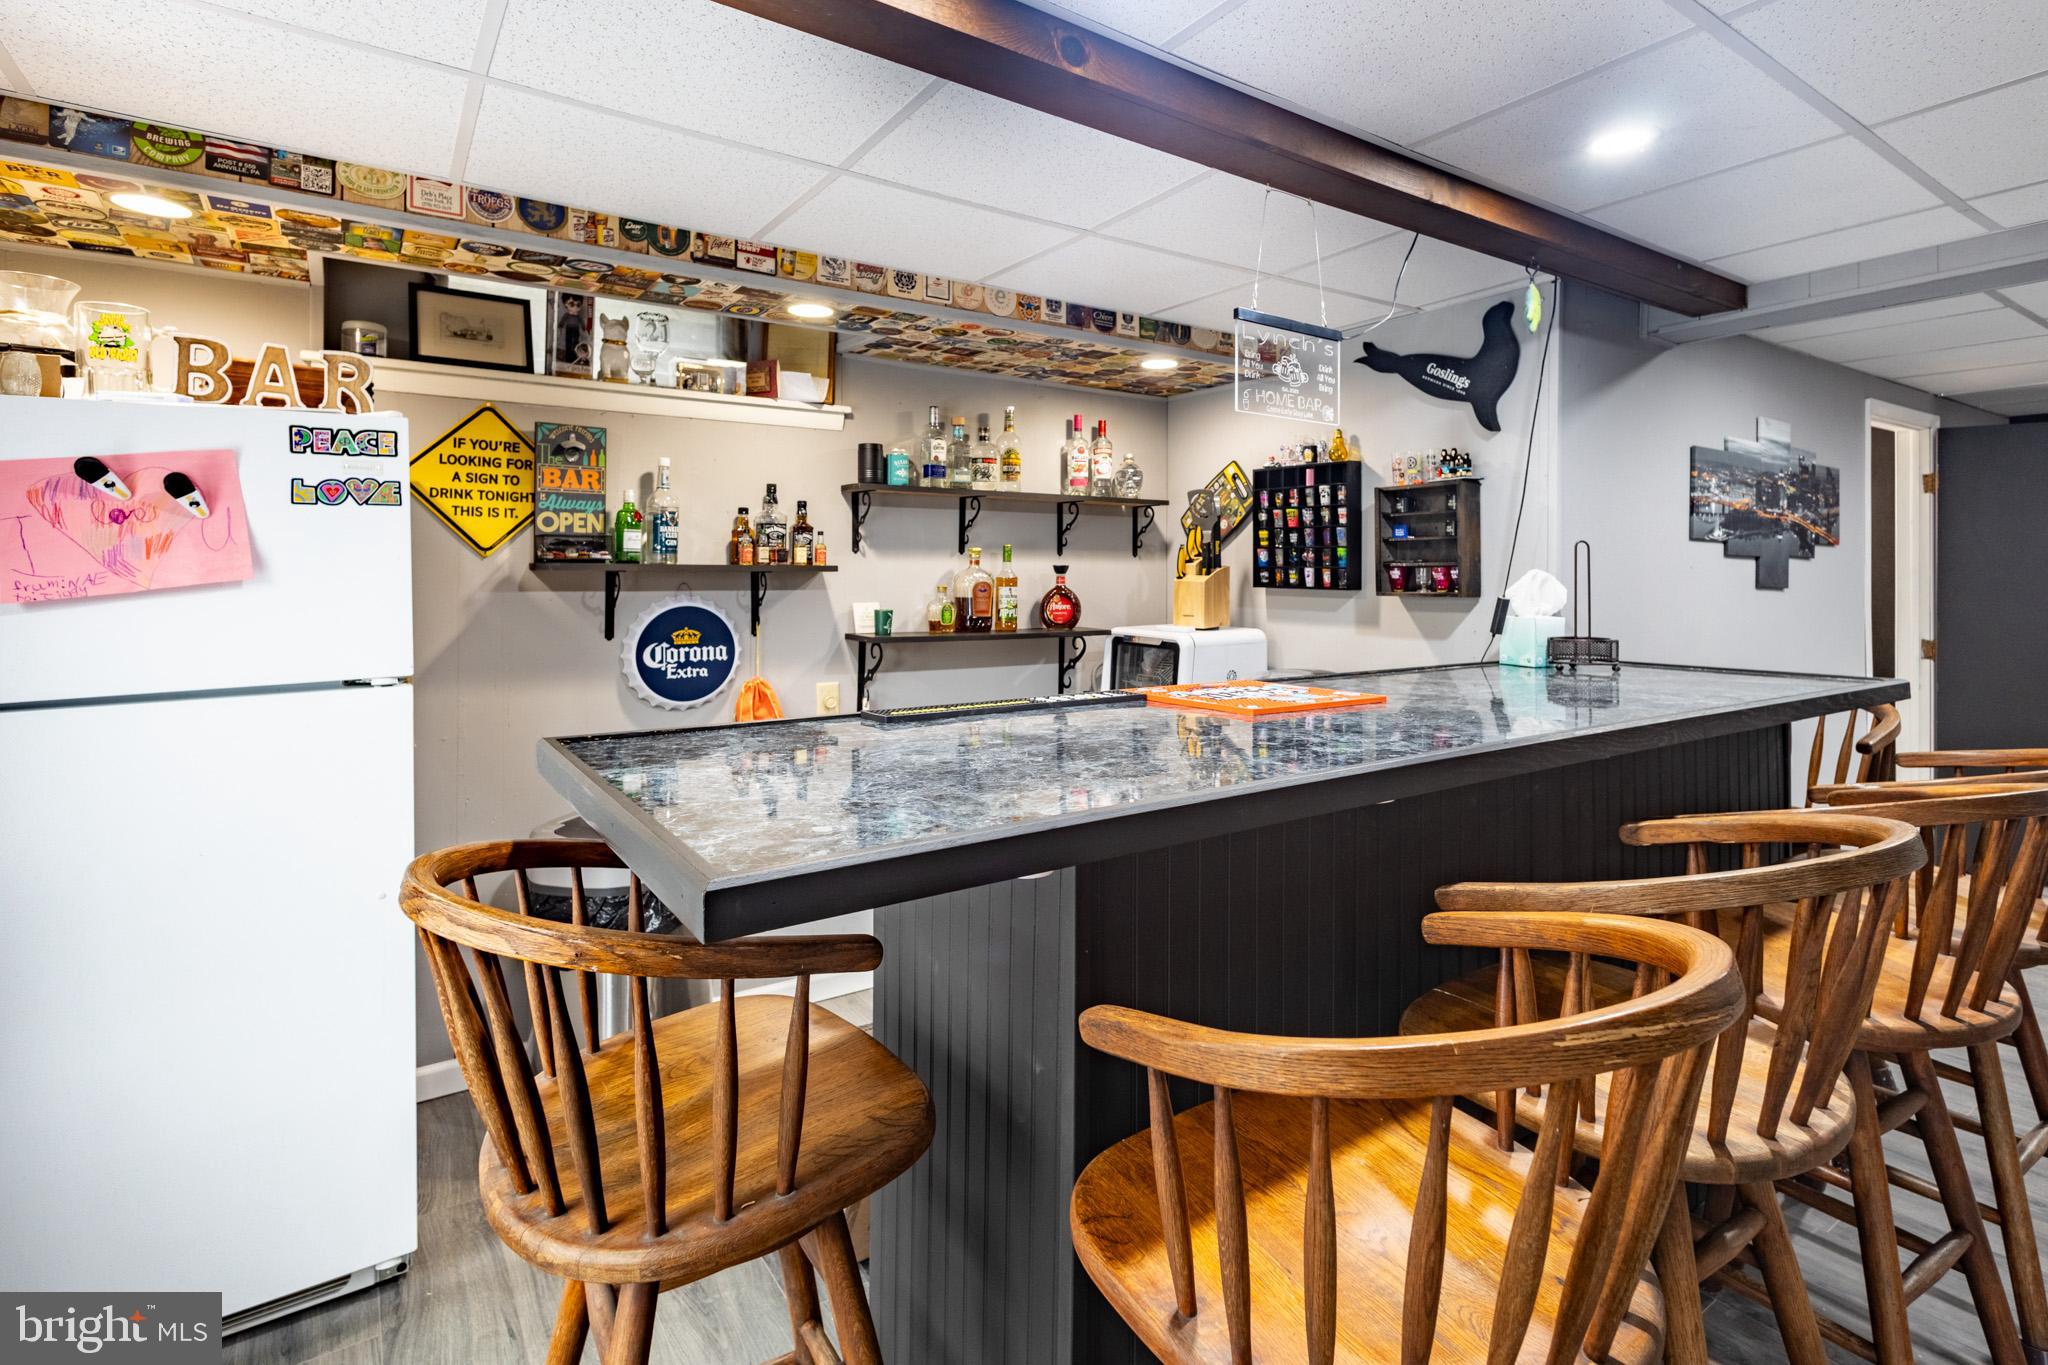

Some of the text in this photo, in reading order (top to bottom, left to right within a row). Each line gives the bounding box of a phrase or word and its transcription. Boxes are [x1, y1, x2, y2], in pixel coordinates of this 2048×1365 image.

[146, 132, 191, 147] BREWING
[143, 146, 191, 165] COMPANY
[217, 157, 238, 167] POST
[1242, 323, 1334, 357] Lynch's
[174, 334, 375, 415] BAR
[1426, 362, 1471, 389] Goslings
[1255, 388, 1296, 408] HOME
[1297, 395, 1323, 413] BAR
[289, 425, 398, 457] PEACE
[453, 438, 520, 453] IF YOU'RE
[439, 454, 533, 470] LOOKING FOR
[452, 473, 520, 485] A SIGN TO
[543, 467, 601, 490] BAR
[291, 477, 402, 506] LOVE
[429, 487, 473, 500] DRINK
[452, 506, 519, 519] THIS IS IT.
[539, 494, 604, 515] Always
[536, 511, 604, 533] OPEN
[643, 641, 728, 671] Corona
[666, 664, 709, 680] Extra
